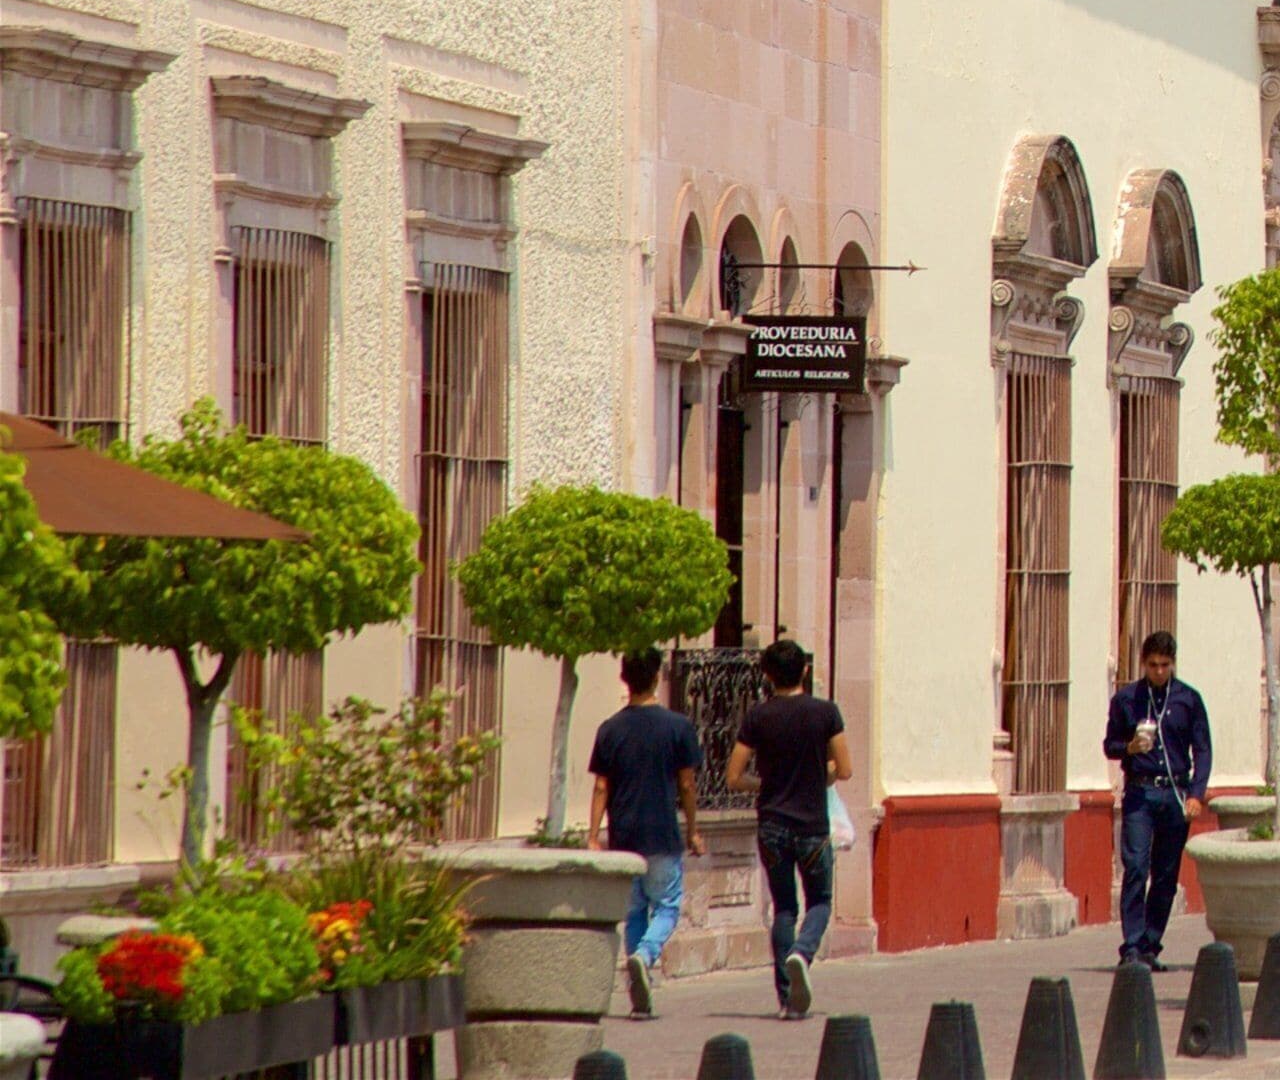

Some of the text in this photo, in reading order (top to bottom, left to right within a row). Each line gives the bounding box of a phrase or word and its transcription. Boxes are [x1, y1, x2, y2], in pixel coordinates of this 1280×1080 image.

[750, 326, 857, 340] PROVEEDURIA
[757, 343, 846, 358] DIOCESANA
[754, 369, 851, 379] ARTICULOS RELIGIOSOS
